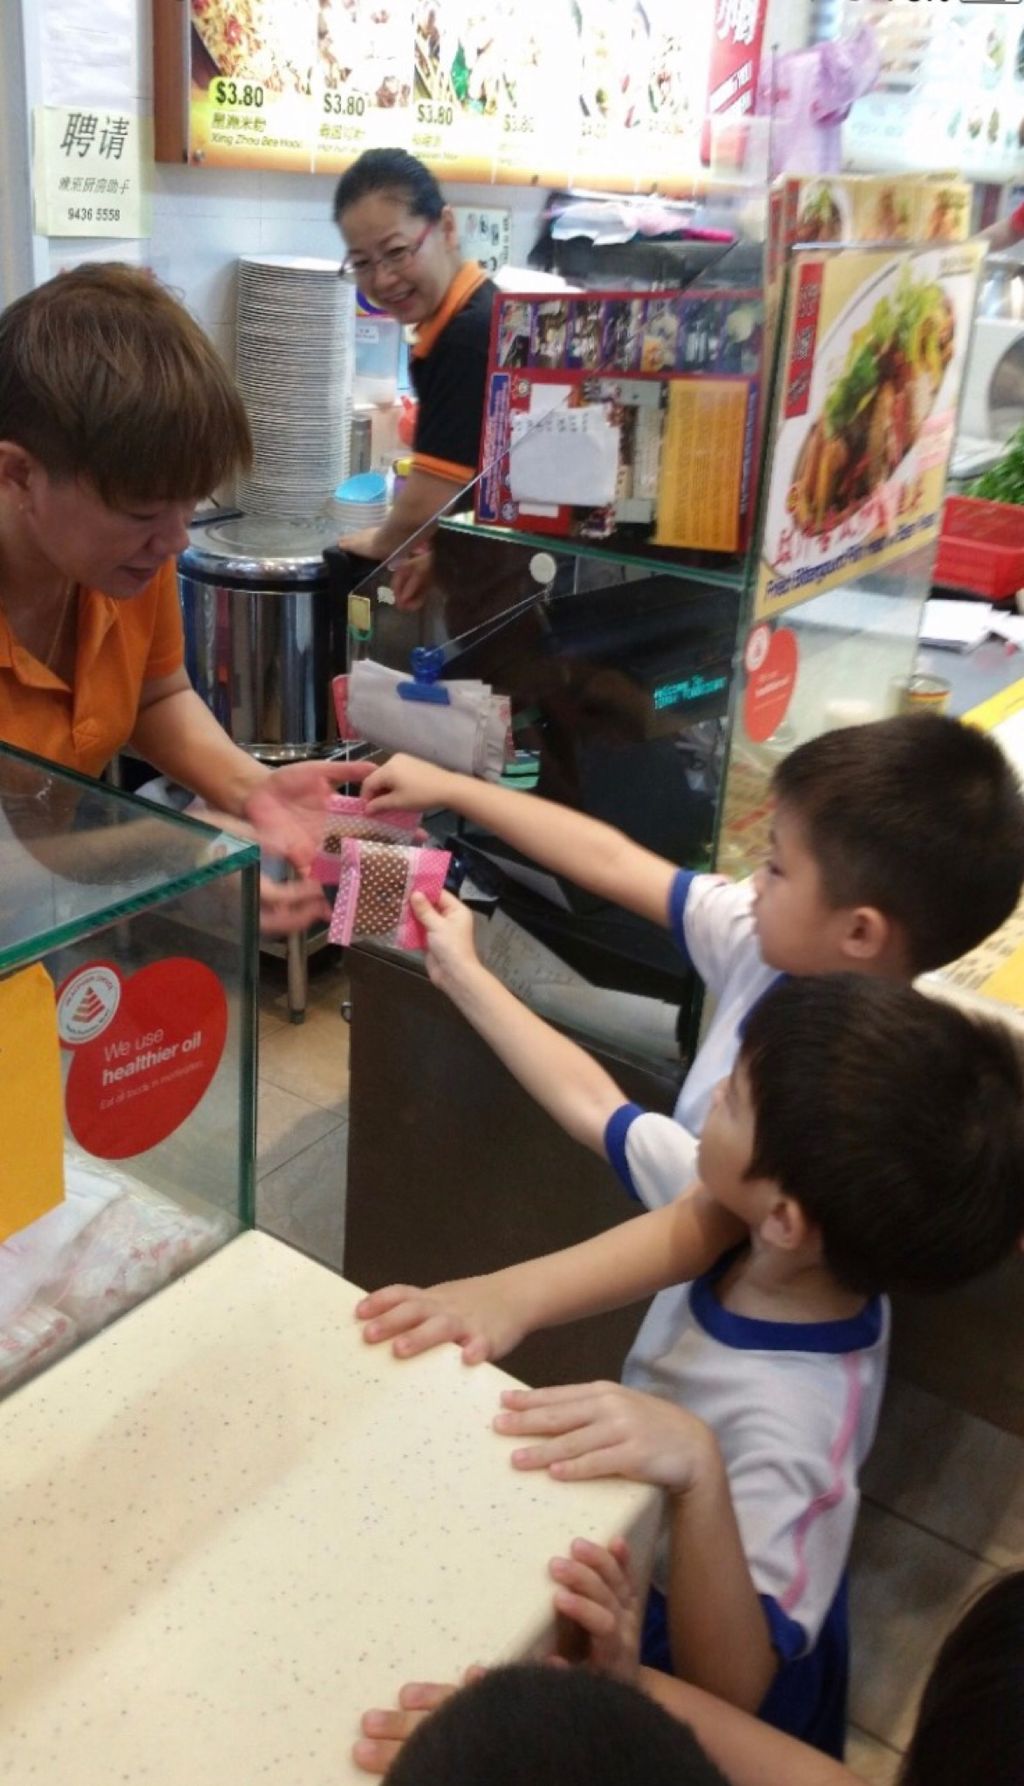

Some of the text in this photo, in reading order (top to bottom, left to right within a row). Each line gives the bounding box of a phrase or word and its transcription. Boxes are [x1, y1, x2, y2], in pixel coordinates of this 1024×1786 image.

[215, 80, 264, 108] $3.80
[323, 92, 365, 117] $3.80
[417, 104, 453, 126] $3.80
[60, 113, 130, 160] 聘请
[67, 207, 121, 222] 9436 5558
[102, 1030, 203, 1087] healthier oil
[104, 1028, 164, 1062] We use
